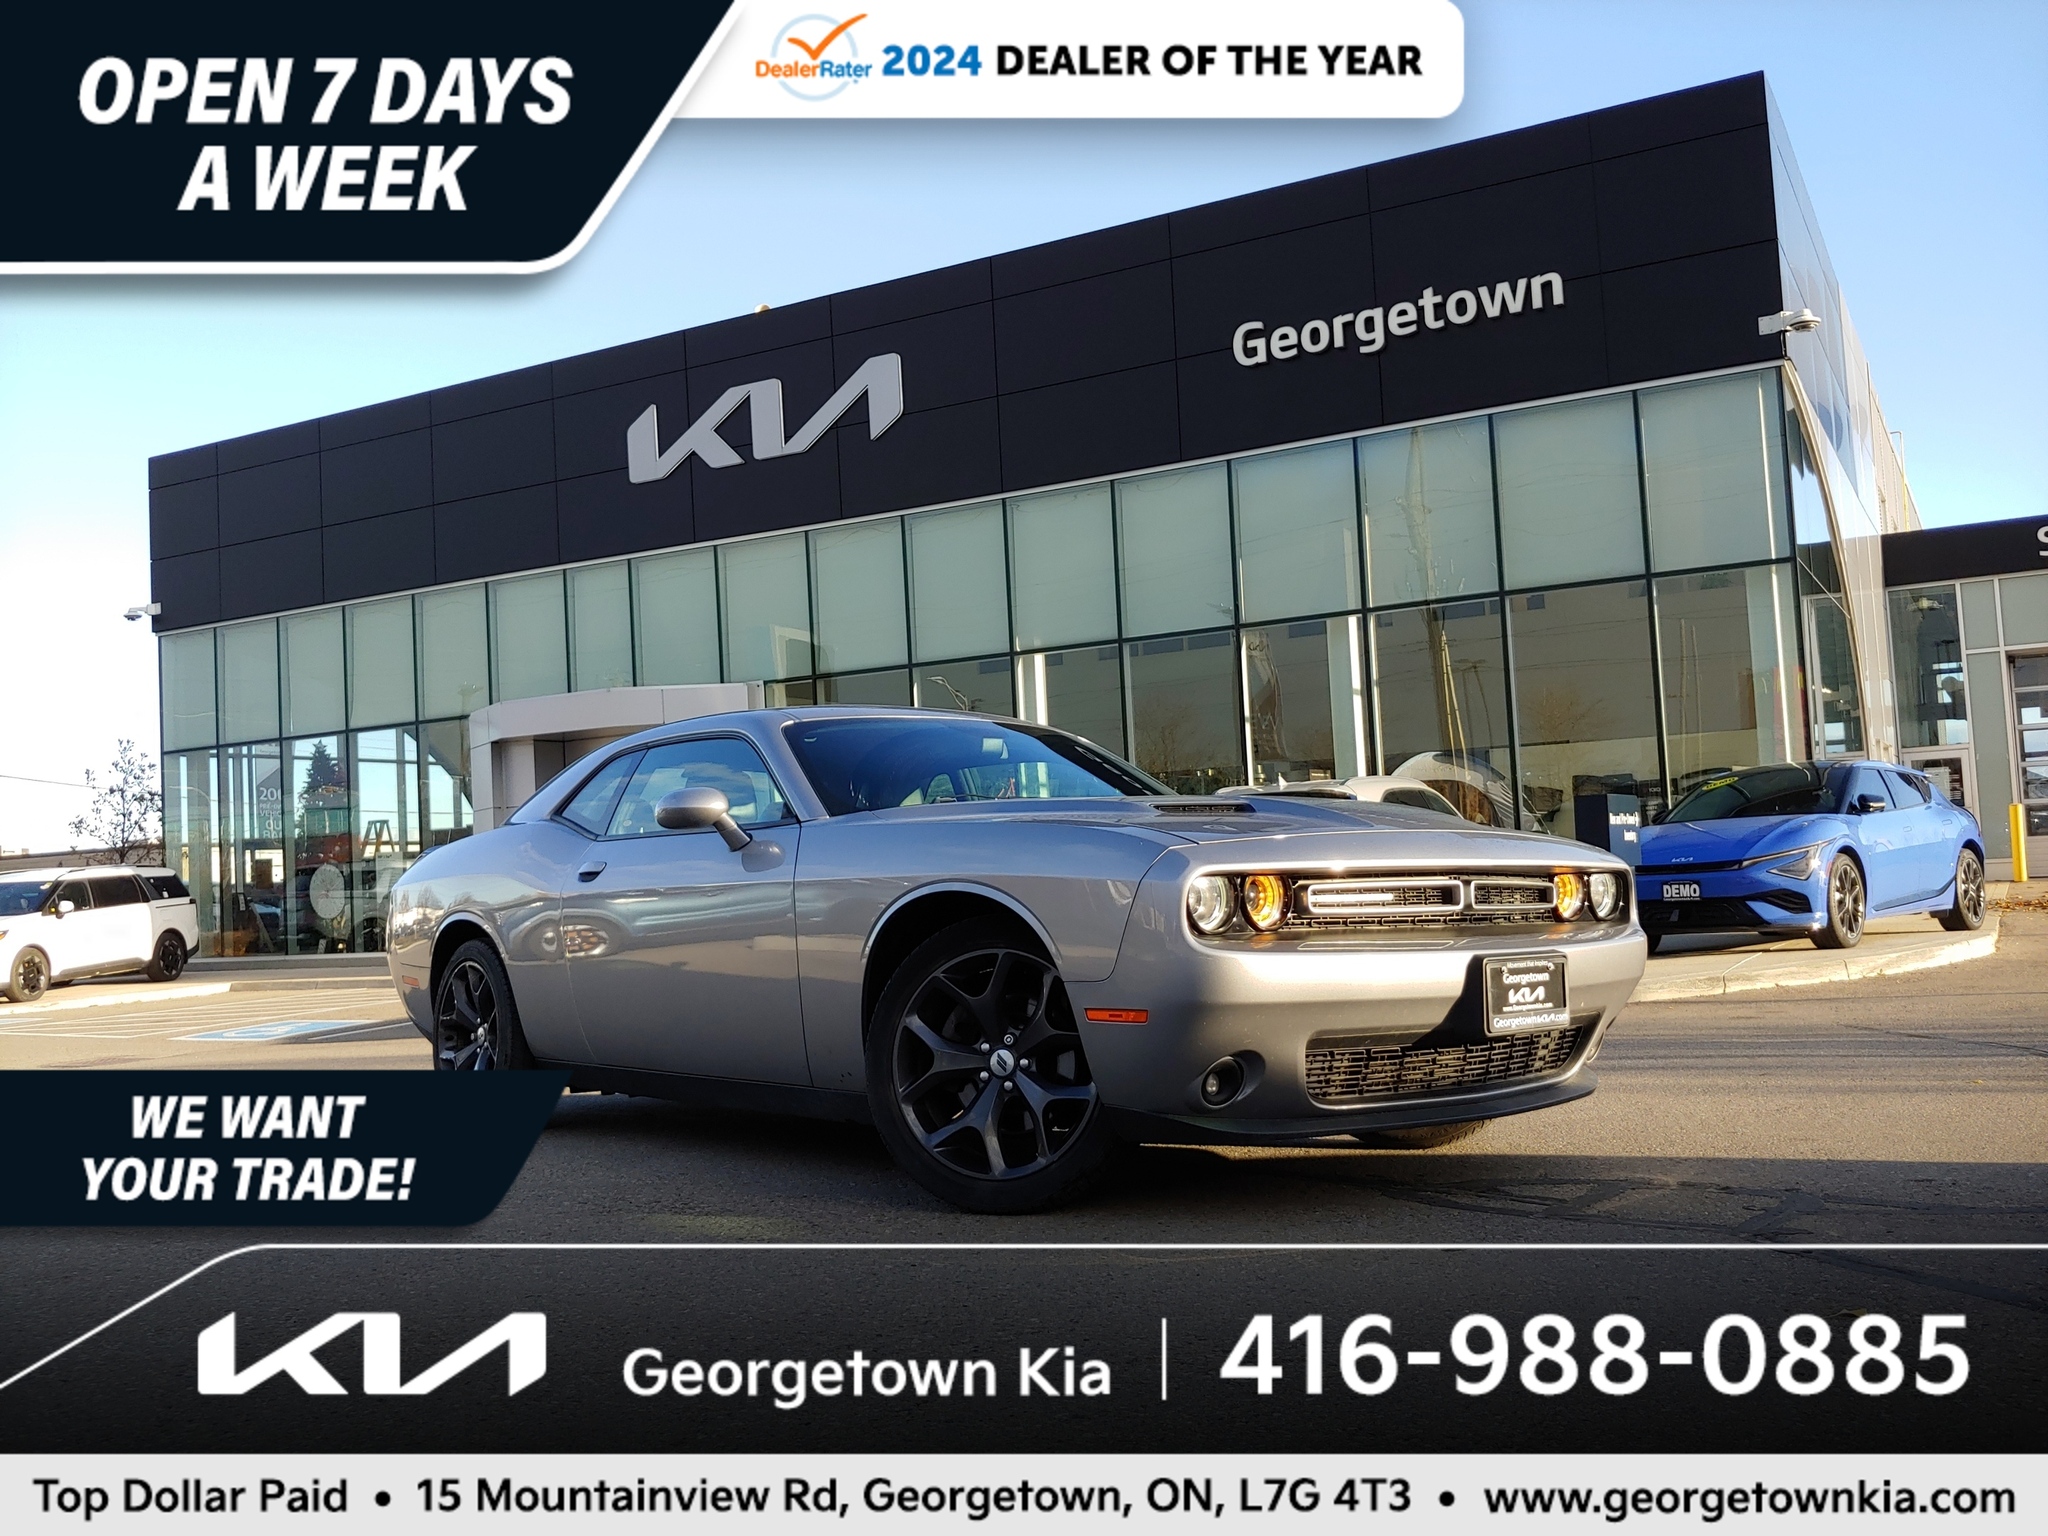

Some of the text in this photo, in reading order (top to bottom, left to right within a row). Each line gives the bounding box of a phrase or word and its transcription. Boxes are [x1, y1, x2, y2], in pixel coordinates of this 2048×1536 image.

[1233, 272, 1565, 366] Georgetown
[627, 352, 904, 484] KIA
[1663, 883, 1700, 898] DEMO
[1503, 972, 1550, 984] Georgetown
[1508, 985, 1545, 1004] KIA
